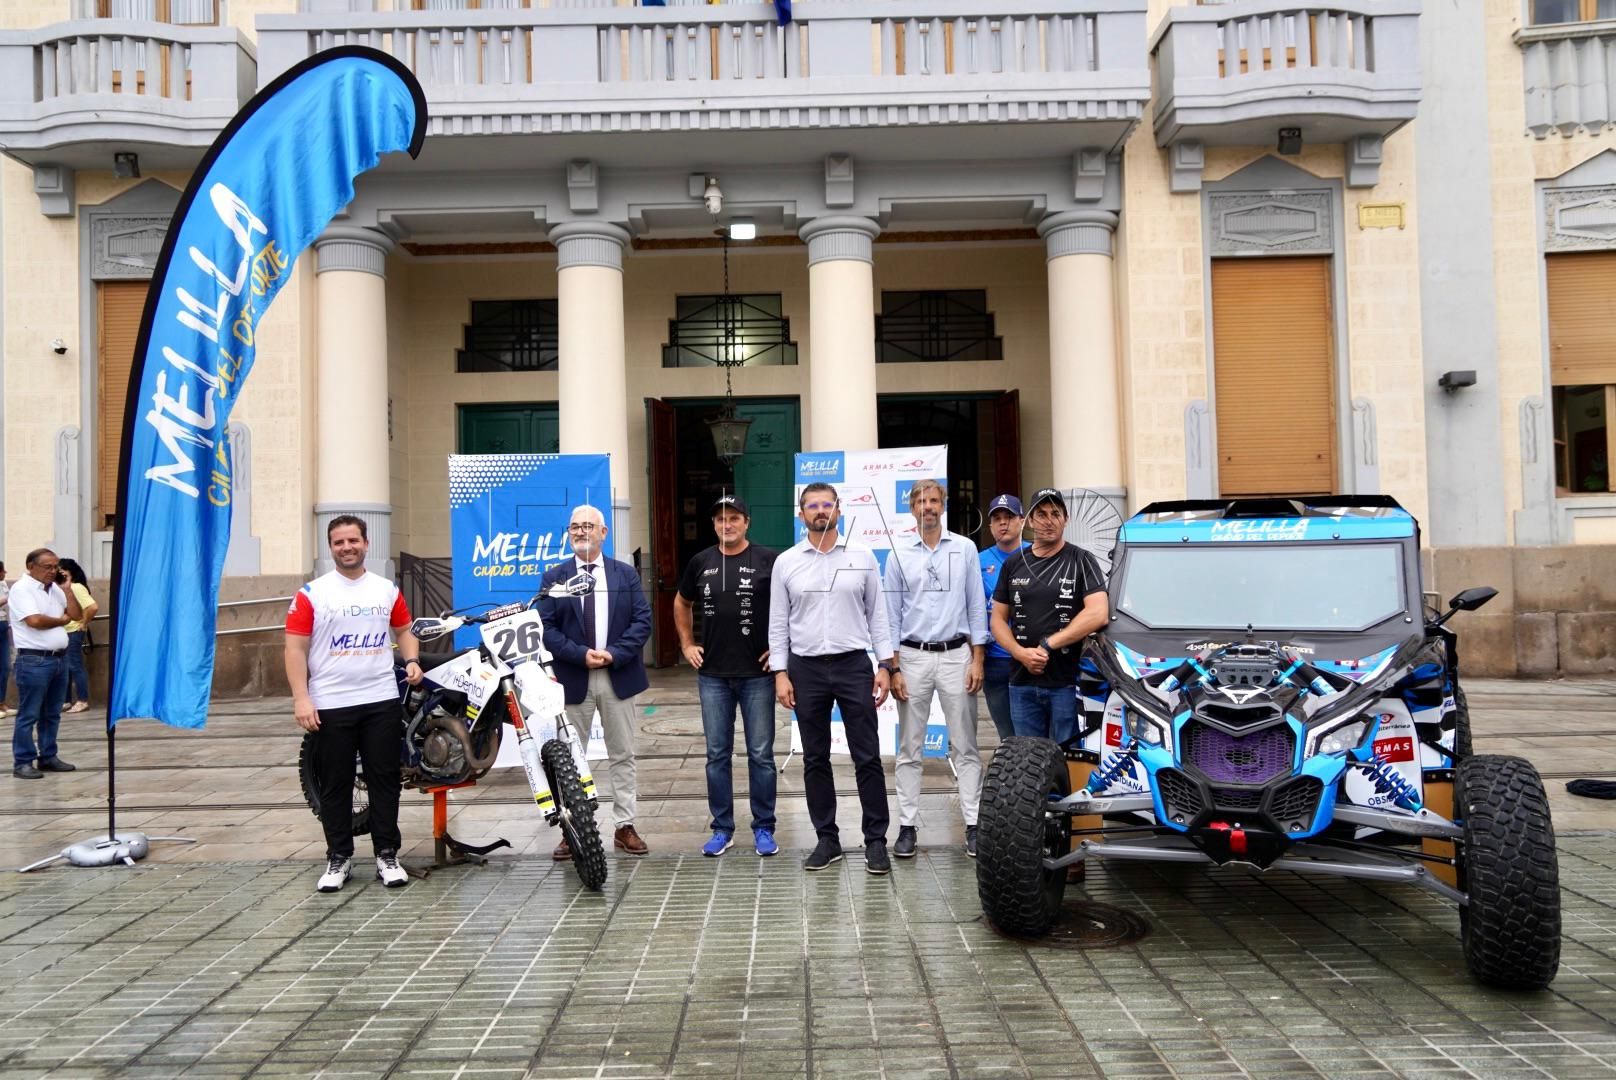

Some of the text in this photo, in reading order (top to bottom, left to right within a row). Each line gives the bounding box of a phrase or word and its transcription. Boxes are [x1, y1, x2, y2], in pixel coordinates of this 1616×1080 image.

[145, 182, 268, 497] MELILLA
[800, 459, 839, 472] MELILLA
[862, 463, 894, 471] ARMAS
[1211, 518, 1311, 534] MELILLA
[471, 531, 575, 564] MELILL
[473, 565, 515, 577] CIUDAD
[519, 563, 541, 576] DEL
[329, 631, 387, 650] MELILLA
[493, 621, 541, 661] 26
[1374, 742, 1410, 755] RMAS
